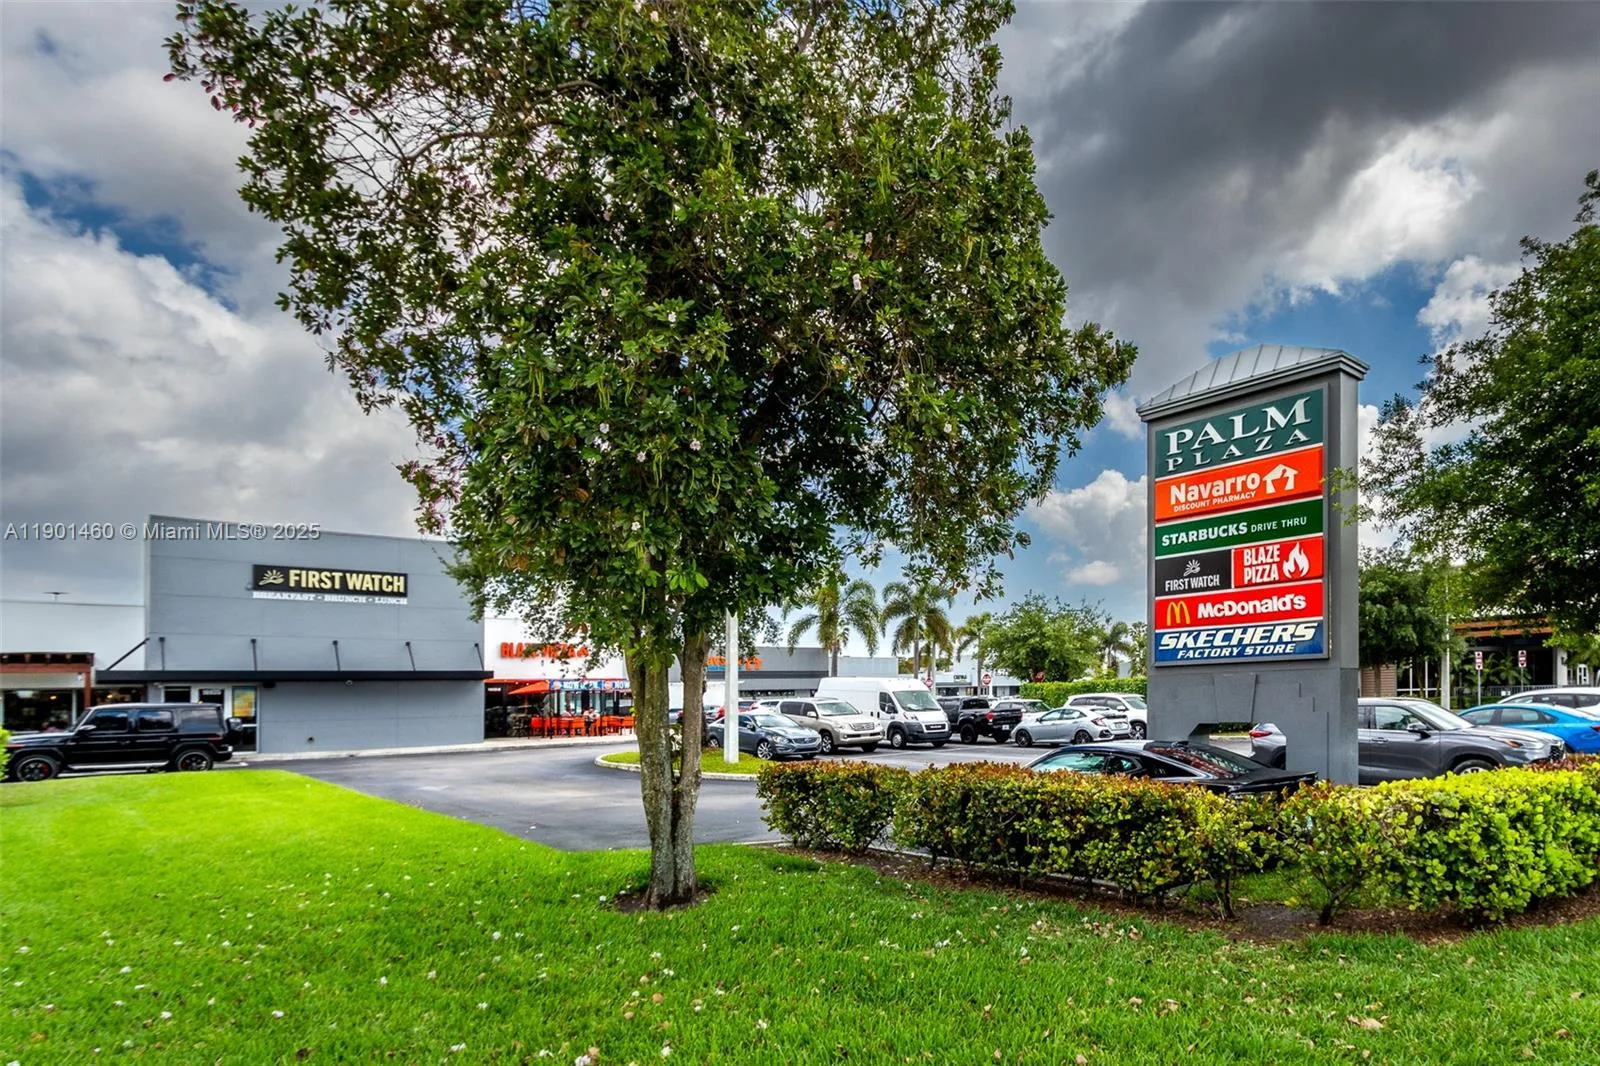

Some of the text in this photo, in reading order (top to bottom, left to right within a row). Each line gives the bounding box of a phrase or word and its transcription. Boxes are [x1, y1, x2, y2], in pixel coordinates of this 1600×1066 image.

[1165, 396, 1312, 455] PALM
[1166, 429, 1309, 471] PLAZA
[1170, 471, 1261, 506] Navarro
[1173, 490, 1256, 513] DISCOUNT PHARMACY
[1161, 516, 1307, 547] STARBUCKS DRIVE THRU
[1243, 543, 1281, 567] BLAZE
[288, 569, 405, 593] FIRST WATCH
[1165, 574, 1220, 592] FIRST WATCH
[1243, 564, 1279, 586] PIZZA
[252, 591, 408, 605] BREAKFAST BRUNCH LUNCH
[1197, 594, 1307, 620] McDonald's
[1158, 622, 1318, 650] SKECHERS
[500, 642, 537, 658] BLA
[1177, 643, 1296, 659] FACTORY STORE
